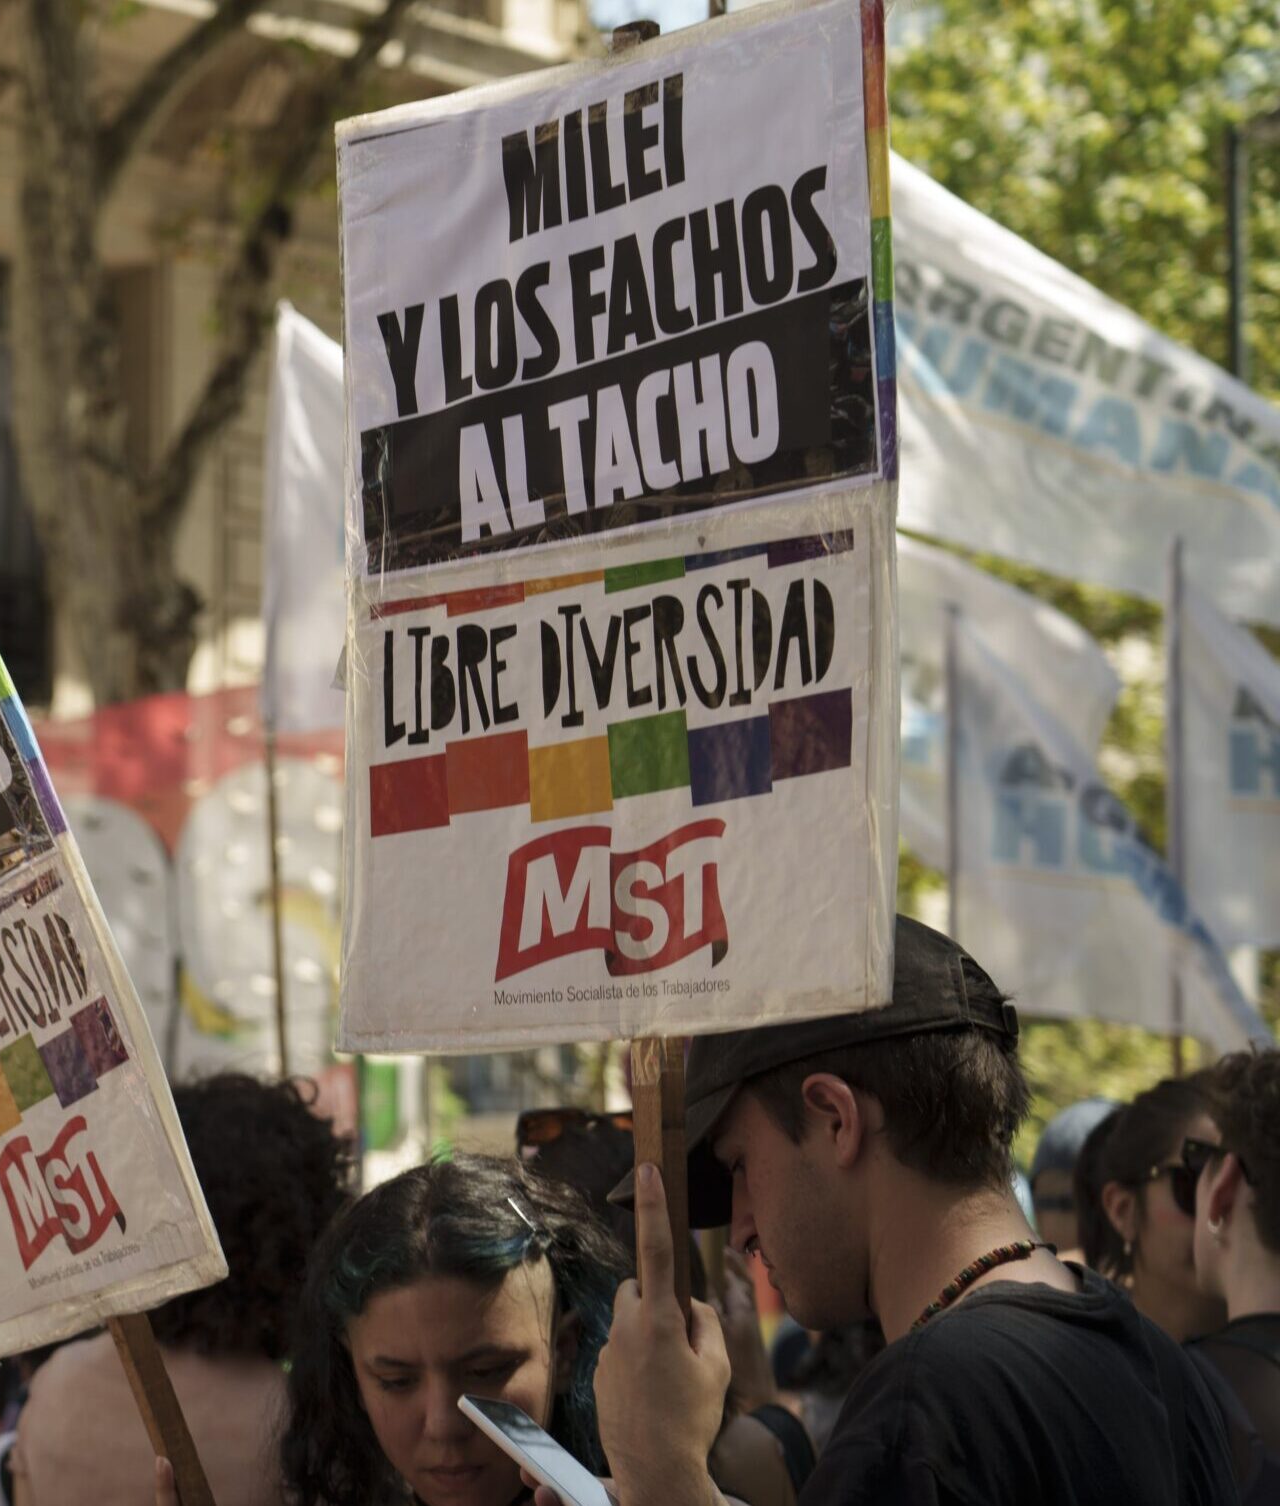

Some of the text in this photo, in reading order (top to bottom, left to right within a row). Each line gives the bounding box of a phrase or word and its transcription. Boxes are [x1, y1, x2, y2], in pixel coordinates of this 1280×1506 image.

[502, 72, 686, 243] MILEI
[377, 165, 838, 418] Y LOS FACHOS
[459, 340, 781, 544] AL TACHO
[383, 577, 836, 748] LIBRE DIVERSIDAD
[515, 836, 723, 964] MST
[493, 977, 731, 1006] Movimiento Socialista de los Trabajadores
[4, 1131, 107, 1247] MST
